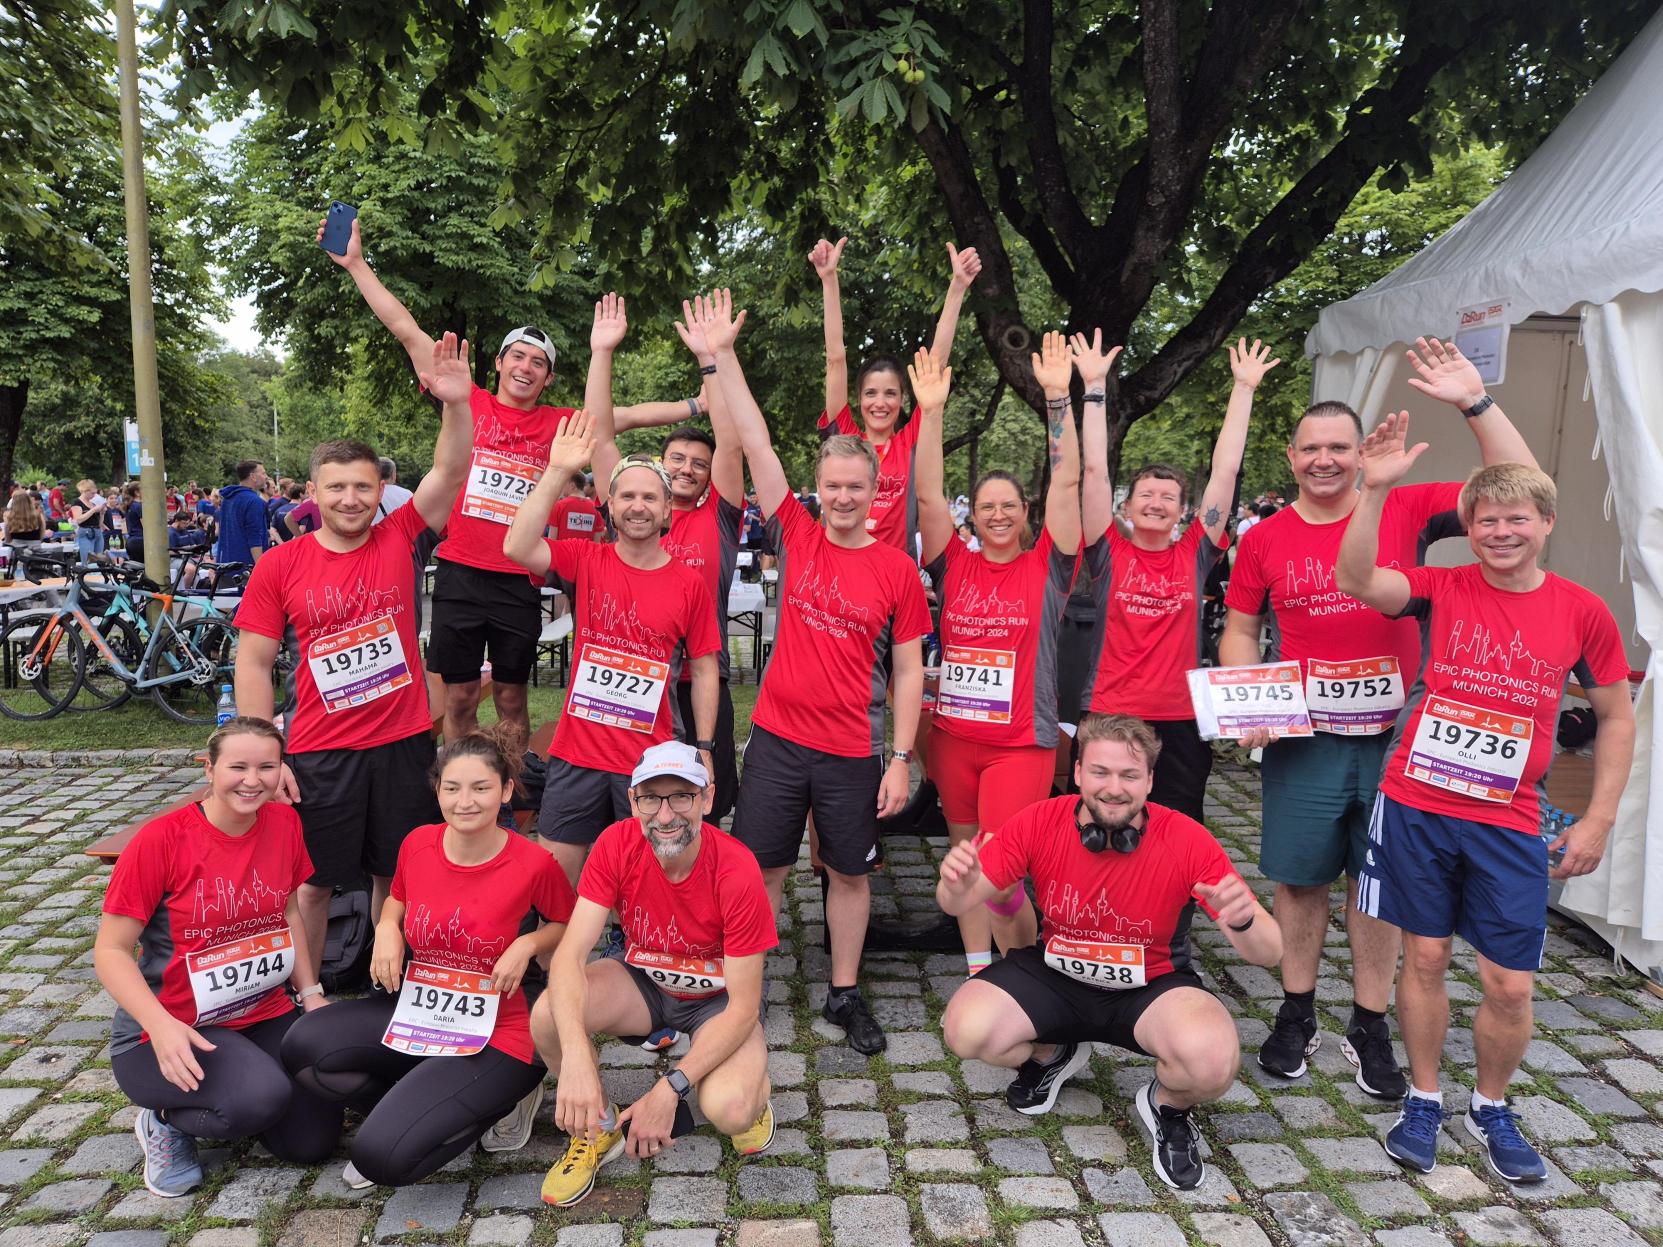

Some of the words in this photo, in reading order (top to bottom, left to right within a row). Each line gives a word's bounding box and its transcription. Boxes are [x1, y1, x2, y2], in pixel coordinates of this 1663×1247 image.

[484, 487, 508, 498] JOAQUIN
[686, 558, 705, 566] RUN
[1284, 596, 1308, 608] EPIC
[1308, 602, 1358, 617] MUNICH
[1126, 604, 1165, 617] MUNICH
[309, 626, 328, 639] EPIC
[331, 608, 384, 633] PHOTONICS
[386, 603, 405, 616] RUN
[847, 621, 867, 635] RUN
[956, 614, 1006, 626] PHOTONICS
[1008, 616, 1029, 626] RUN
[828, 626, 848, 639] 2024
[951, 625, 985, 637] MUNICH
[986, 628, 1009, 637] 2024
[596, 632, 648, 654] PHOTONICS
[321, 637, 393, 676] 19735
[349, 662, 378, 677] MAHAMA
[946, 664, 1003, 687] 19741
[587, 665, 655, 696] 19727
[955, 683, 986, 692] FRANZISKA
[1317, 678, 1393, 699] 19752
[1433, 662, 1459, 676] EPIC
[1461, 667, 1539, 693] PHOTONICS
[1540, 685, 1558, 699] RUN
[606, 689, 628, 699] GEORG
[1221, 684, 1294, 702] 19745
[1452, 680, 1508, 700] MUNICH
[1428, 720, 1518, 760] 19736
[1457, 751, 1477, 761] OLLI
[1432, 761, 1464, 775] STARTZEIT
[1482, 773, 1495, 783] Uhr
[184, 928, 213, 939] EPIC
[216, 912, 283, 936] PHOTONICS
[206, 929, 255, 946] MUNICH
[1060, 925, 1126, 943] PHOTONICS
[1129, 936, 1154, 945] RUN
[414, 949, 479, 965] PHOTONICS
[205, 953, 285, 993] 19744
[459, 963, 484, 972] 2024
[1057, 957, 1134, 984] 19738
[235, 981, 261, 994] MIRIAM
[410, 986, 486, 1017] 19743
[433, 1014, 455, 1023] DARIA
[413, 1029, 441, 1040] STARTZEIT
